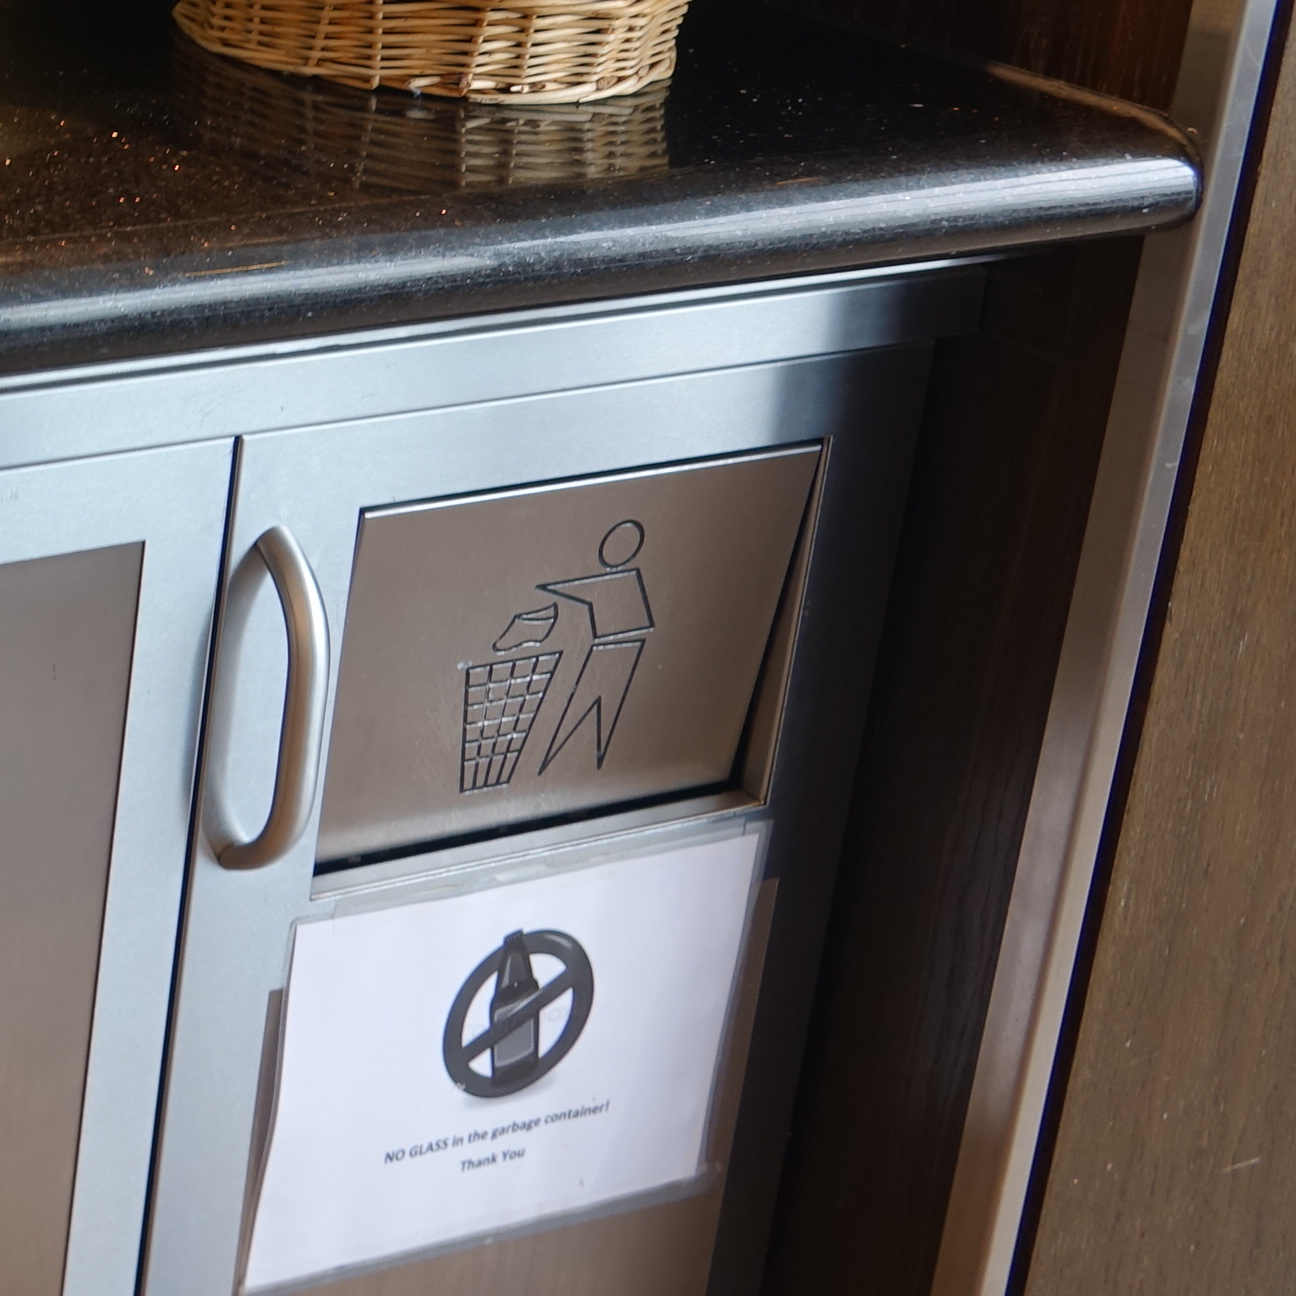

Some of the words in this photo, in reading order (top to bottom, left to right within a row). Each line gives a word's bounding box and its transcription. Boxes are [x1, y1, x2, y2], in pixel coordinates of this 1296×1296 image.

[383, 1150, 405, 1164] NO
[409, 1137, 450, 1159] GLASS
[451, 1134, 463, 1147] in
[467, 1127, 488, 1145] the
[490, 1117, 541, 1141] garbage
[544, 1099, 610, 1125] container!
[459, 1155, 498, 1173] Thank
[501, 1147, 526, 1163] You
